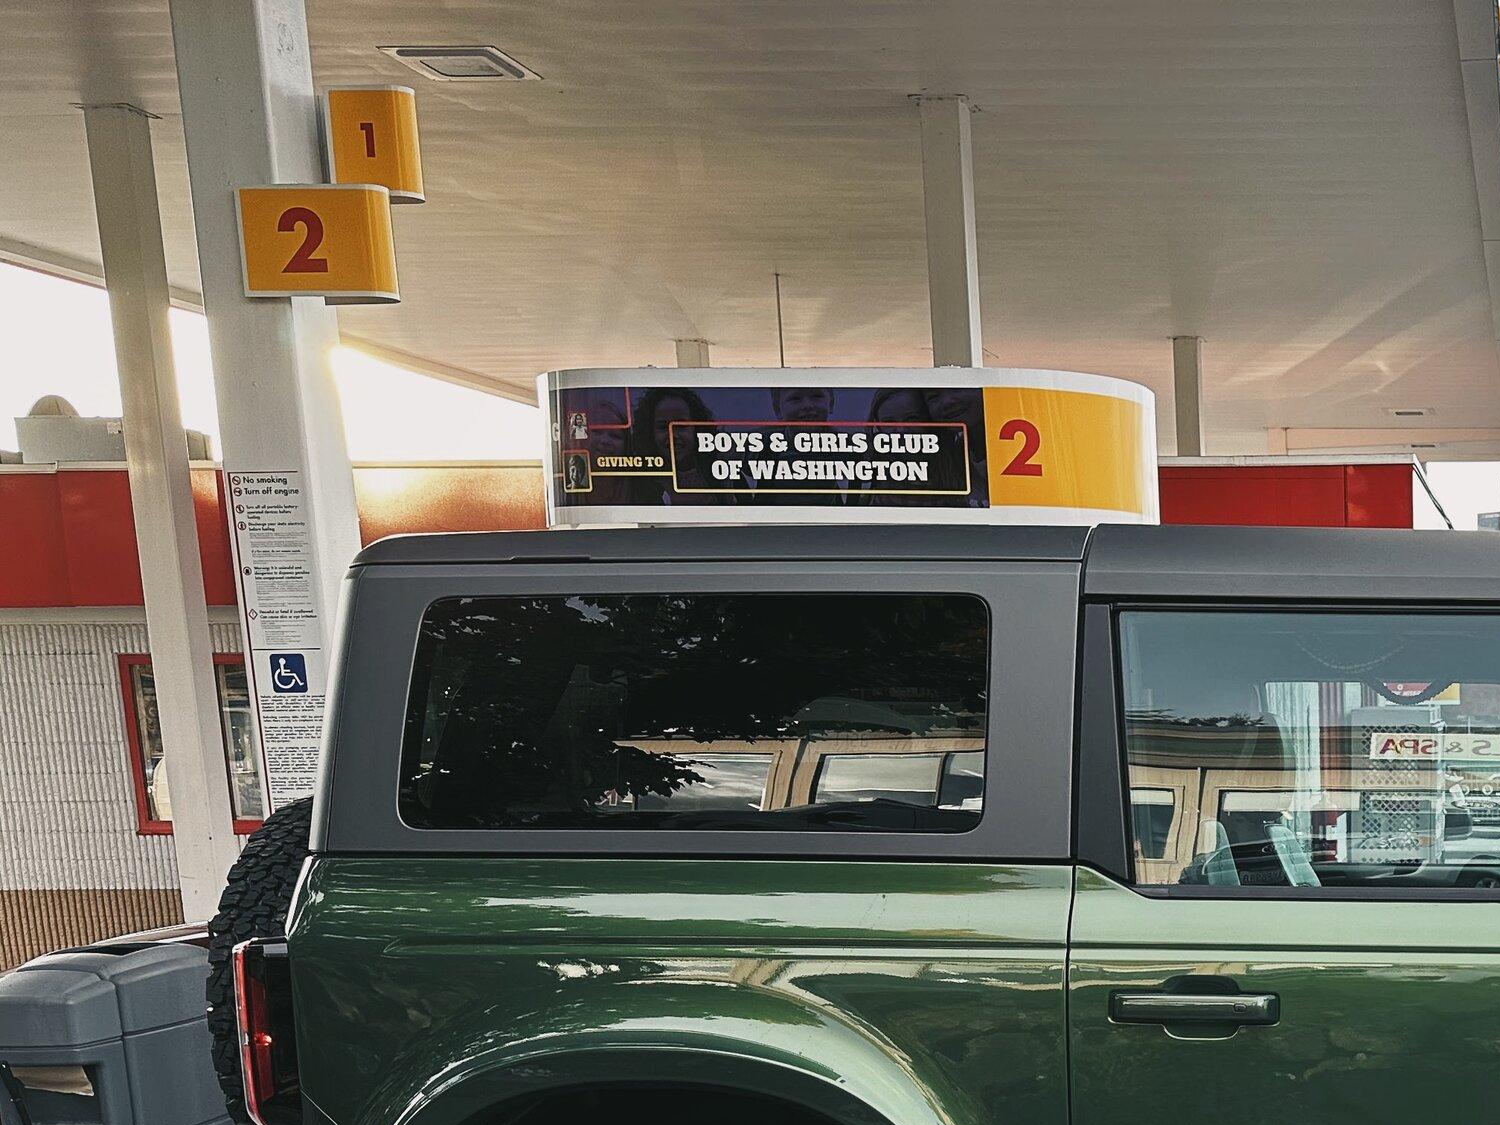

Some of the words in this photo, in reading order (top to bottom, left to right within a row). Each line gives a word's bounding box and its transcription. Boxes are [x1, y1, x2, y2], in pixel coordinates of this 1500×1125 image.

[359, 122, 376, 158] 1
[277, 206, 329, 274] 2
[696, 432, 764, 453] BOYS
[769, 433, 789, 453] &
[793, 432, 869, 454] GIRLS
[873, 433, 941, 455] CLUB
[998, 418, 1043, 477] 2
[596, 456, 643, 468] GIVING
[644, 456, 664, 468] TO
[711, 460, 743, 481] OF
[748, 460, 929, 482] WASHINGTON
[242, 476, 255, 484] No
[256, 475, 288, 486] smoking
[244, 487, 260, 495] Turn
[261, 486, 272, 495] off
[274, 488, 300, 497] engine
